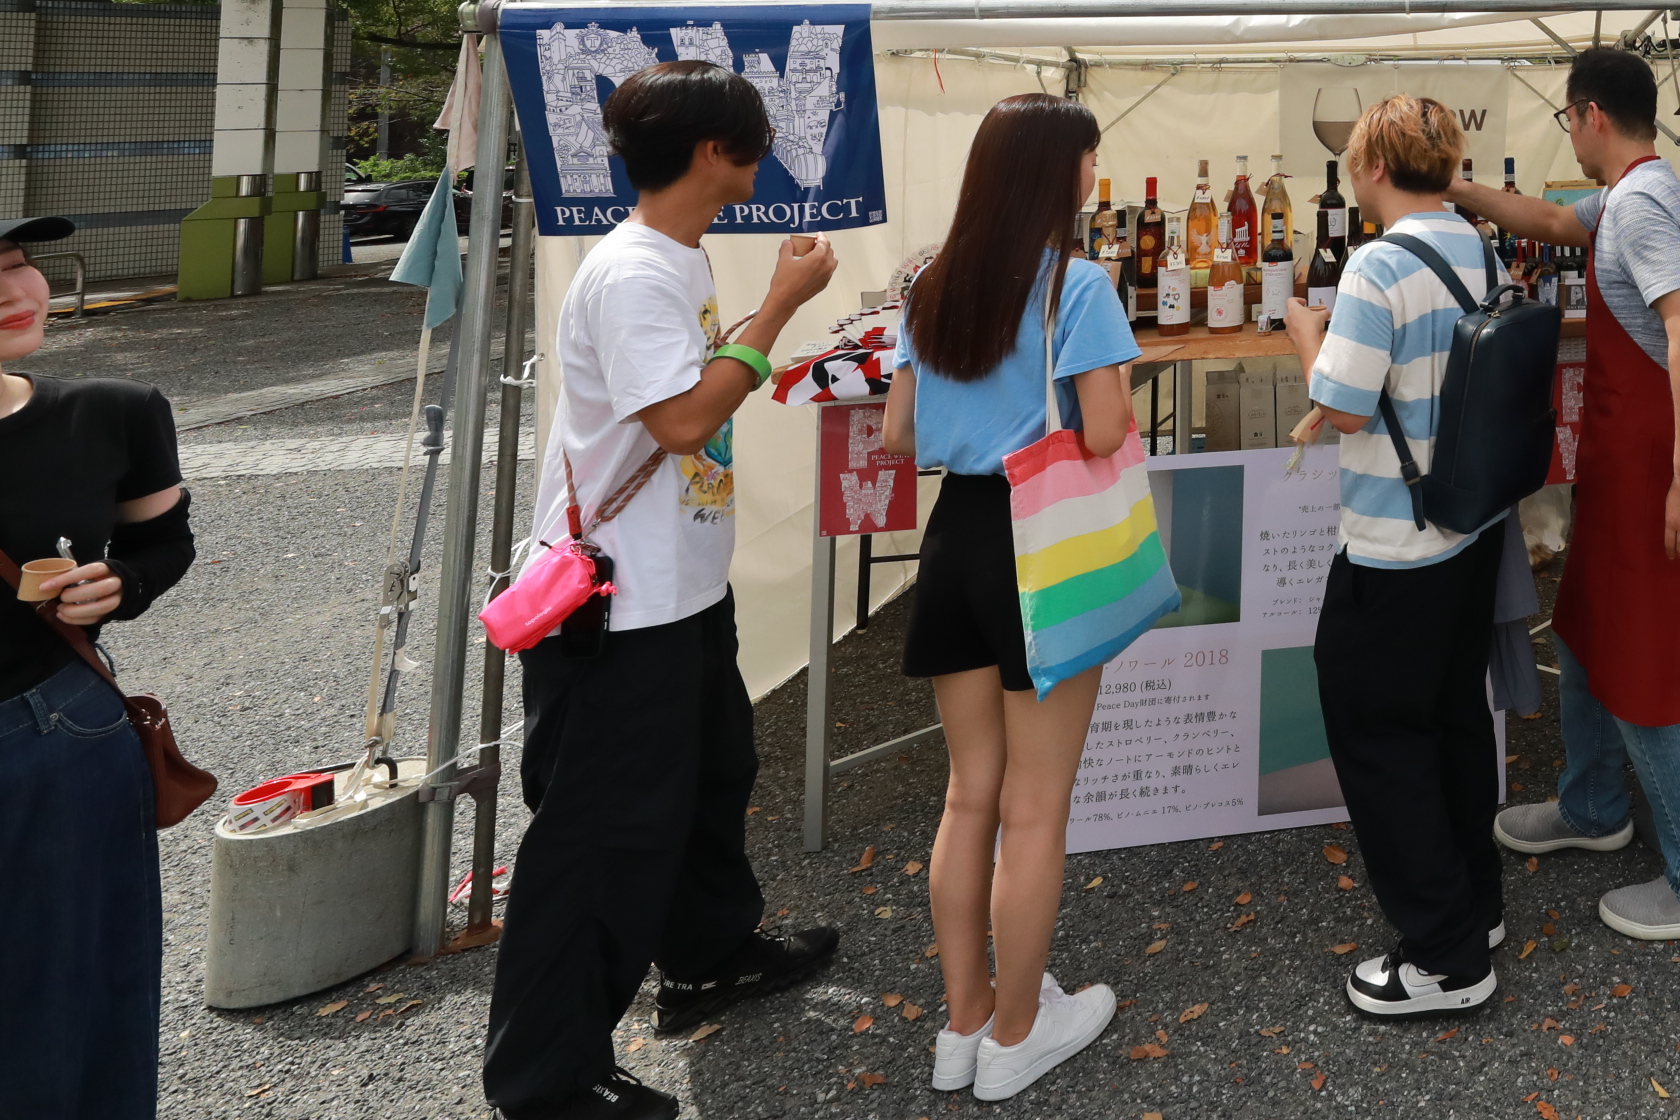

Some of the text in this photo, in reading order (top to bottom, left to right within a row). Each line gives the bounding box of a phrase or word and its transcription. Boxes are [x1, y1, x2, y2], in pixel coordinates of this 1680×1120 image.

[1450, 109, 1487, 131] W
[734, 196, 863, 228] PROJECT
[876, 459, 905, 467] PROJECT
[1277, 575, 1328, 588] 導くエレガ
[1184, 648, 1229, 668] 2018
[1098, 681, 1137, 695] 12,980
[1096, 701, 1121, 711] Peace
[677, 982, 693, 990] TRA
[1460, 996, 1471, 1005] AIR
